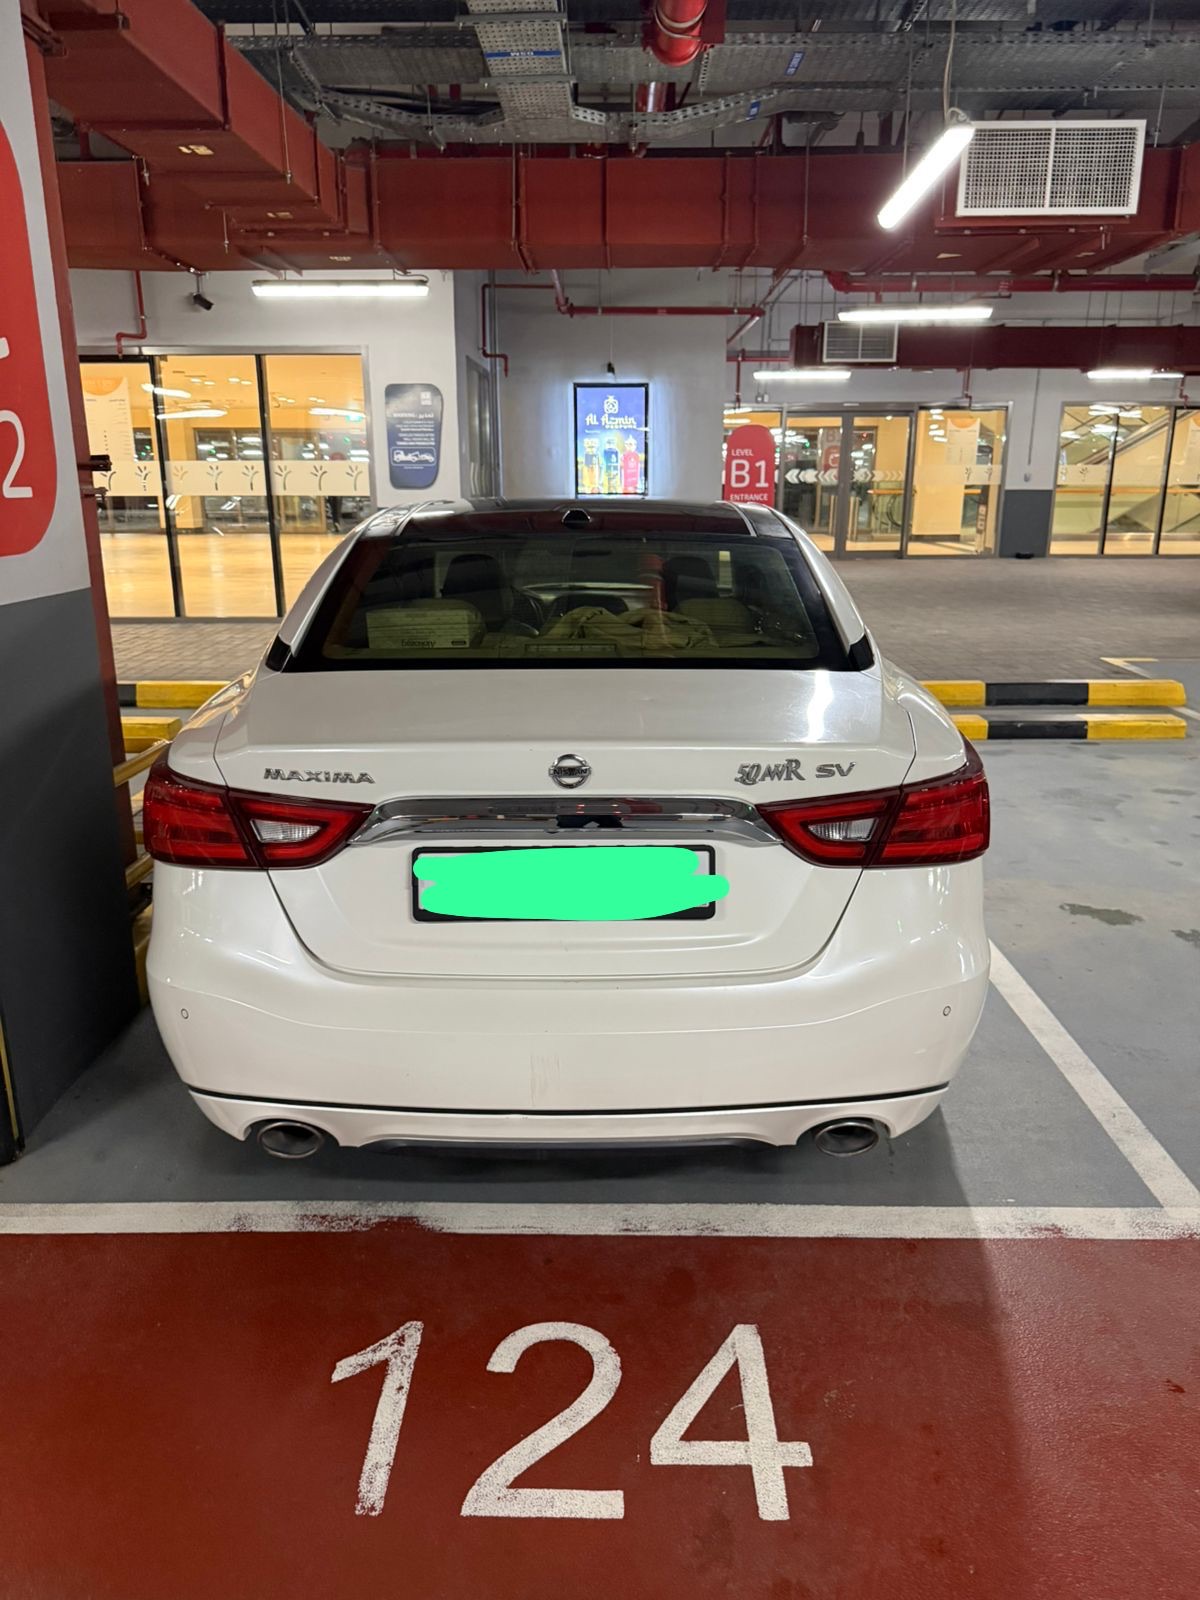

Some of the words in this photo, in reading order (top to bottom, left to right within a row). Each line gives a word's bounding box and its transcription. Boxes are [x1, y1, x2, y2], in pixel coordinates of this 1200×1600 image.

[730, 459, 769, 488] B1
[730, 493, 768, 502] ENTRANCE
[263, 767, 376, 784] MAXIMA
[815, 761, 857, 779] SV
[331, 1320, 813, 1521] 124
